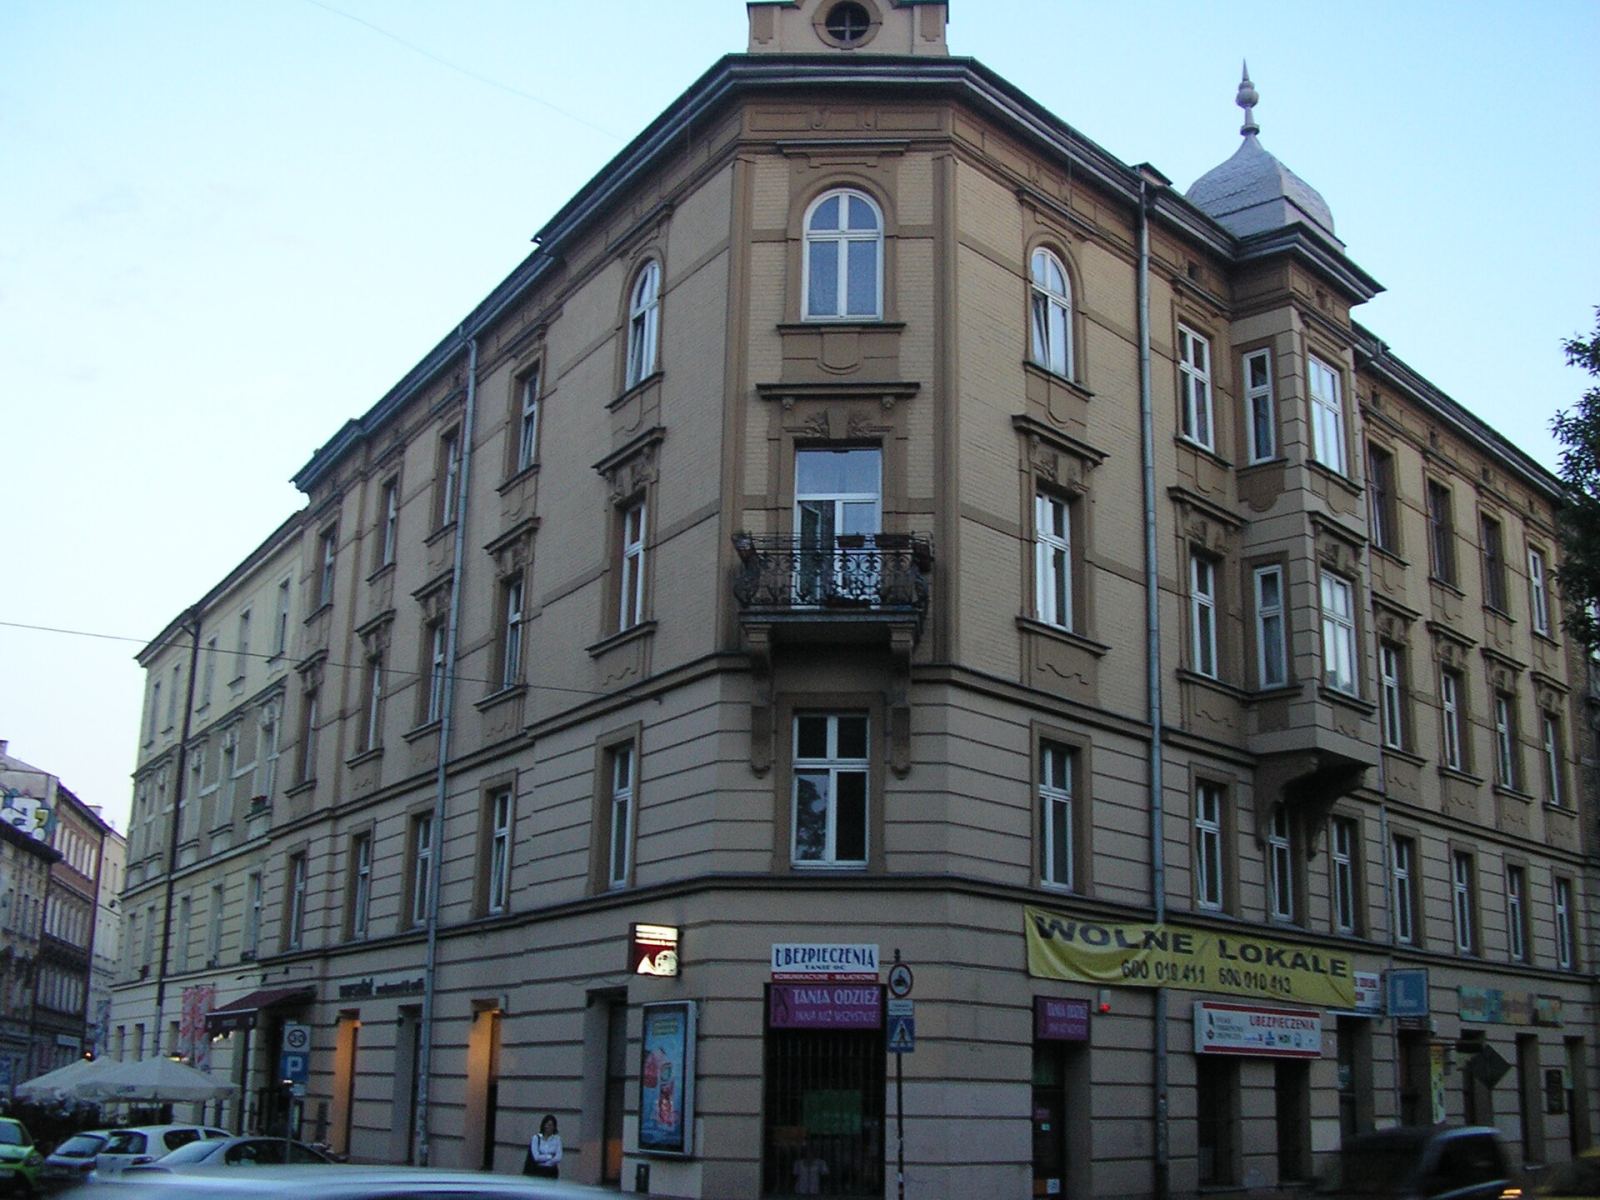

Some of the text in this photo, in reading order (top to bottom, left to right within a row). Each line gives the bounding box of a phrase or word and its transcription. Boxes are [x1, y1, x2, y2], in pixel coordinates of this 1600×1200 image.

[1034, 915, 1347, 978] WOLNE LOKALE
[775, 947, 874, 968] UBEZPIECZENIA
[792, 986, 880, 1005] TANIA ODZIEŻ
[1249, 1015, 1315, 1031] UBEZPIECZENIA
[287, 1056, 303, 1078] P
